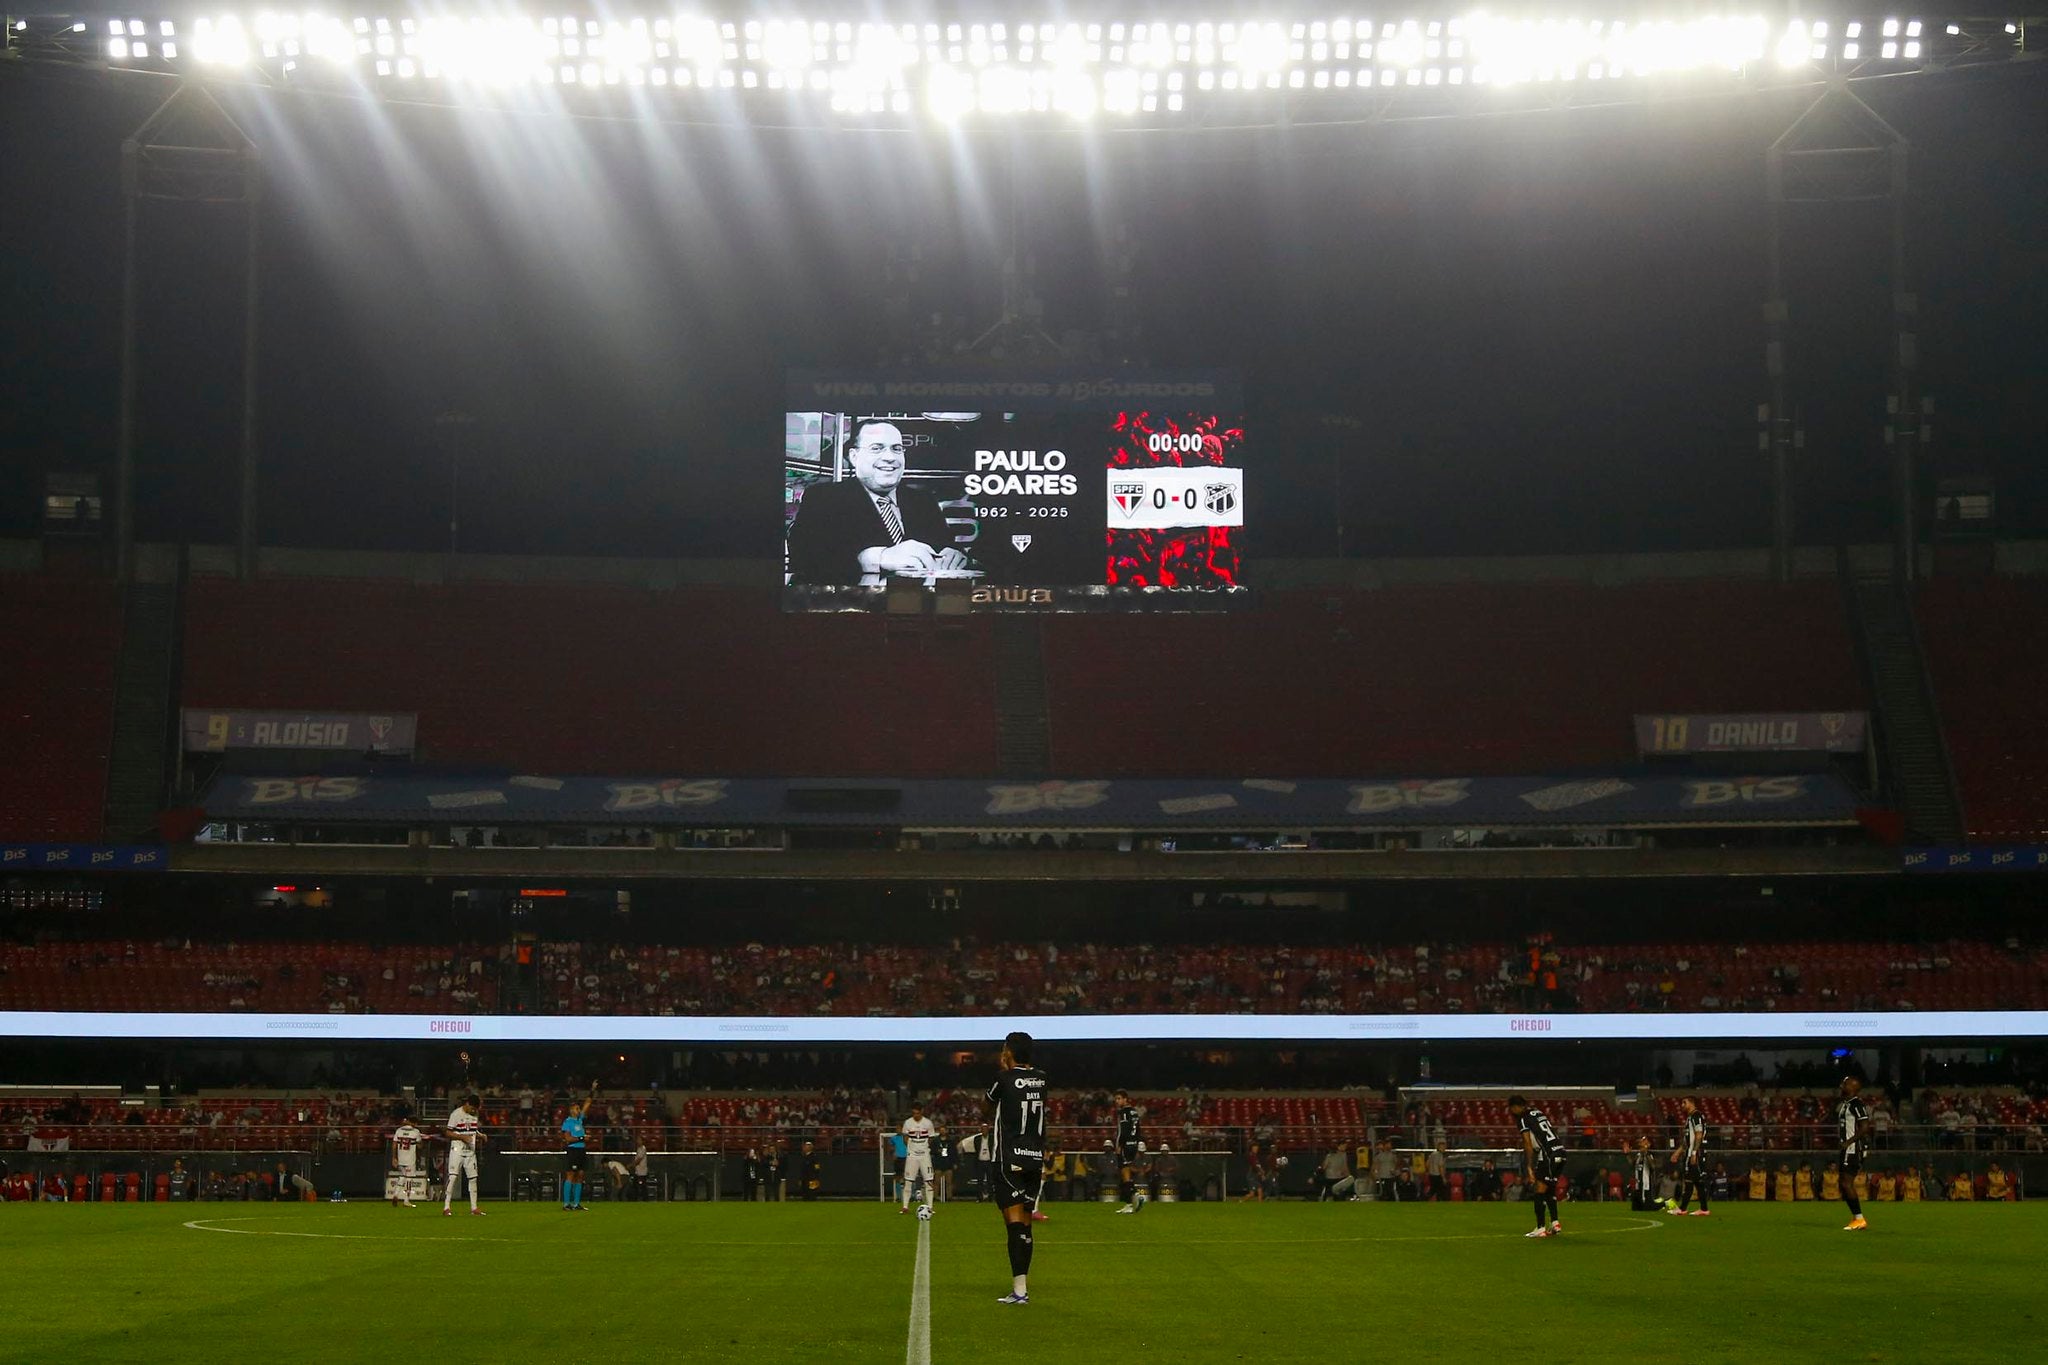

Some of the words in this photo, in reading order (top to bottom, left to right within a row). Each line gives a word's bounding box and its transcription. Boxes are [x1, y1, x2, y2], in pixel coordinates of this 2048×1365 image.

[813, 382, 879, 397] VIVA
[885, 382, 1053, 397] MOMENTOS
[1149, 434, 1202, 452] 00:00
[974, 450, 1066, 472] PAULO
[964, 474, 1078, 496] SOARES
[1113, 485, 1144, 495] SPFC
[1153, 488, 1166, 509] 0
[1184, 488, 1197, 509] 0
[973, 507, 1008, 518] 1962
[1029, 507, 1069, 518] 2025
[971, 588, 1052, 603] aiwa
[206, 715, 229, 750] 9
[1652, 717, 1689, 751] 10
[1706, 720, 1798, 747] DANILO
[430, 1021, 471, 1033] CHEGOU
[1511, 1019, 1552, 1031] CHEGOU
[1021, 1101, 1044, 1136] 17
